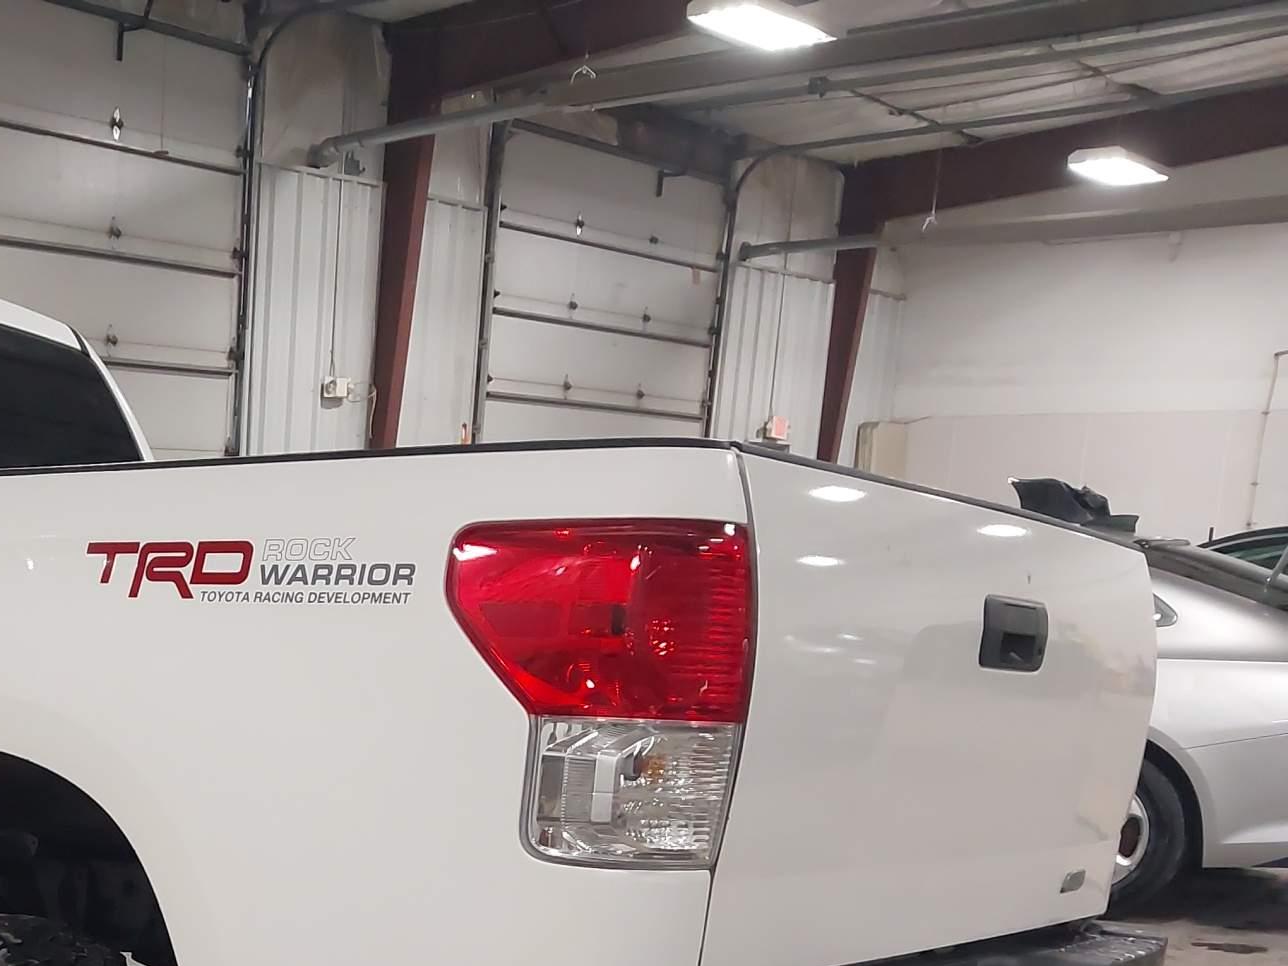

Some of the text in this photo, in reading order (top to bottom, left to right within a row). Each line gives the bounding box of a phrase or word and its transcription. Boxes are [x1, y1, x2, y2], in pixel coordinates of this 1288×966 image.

[262, 537, 357, 562] ROCK
[86, 540, 254, 600] TRD
[259, 562, 417, 587] WARRIOR
[200, 590, 411, 605] TOYOTA RACING DEVELOPMENT
